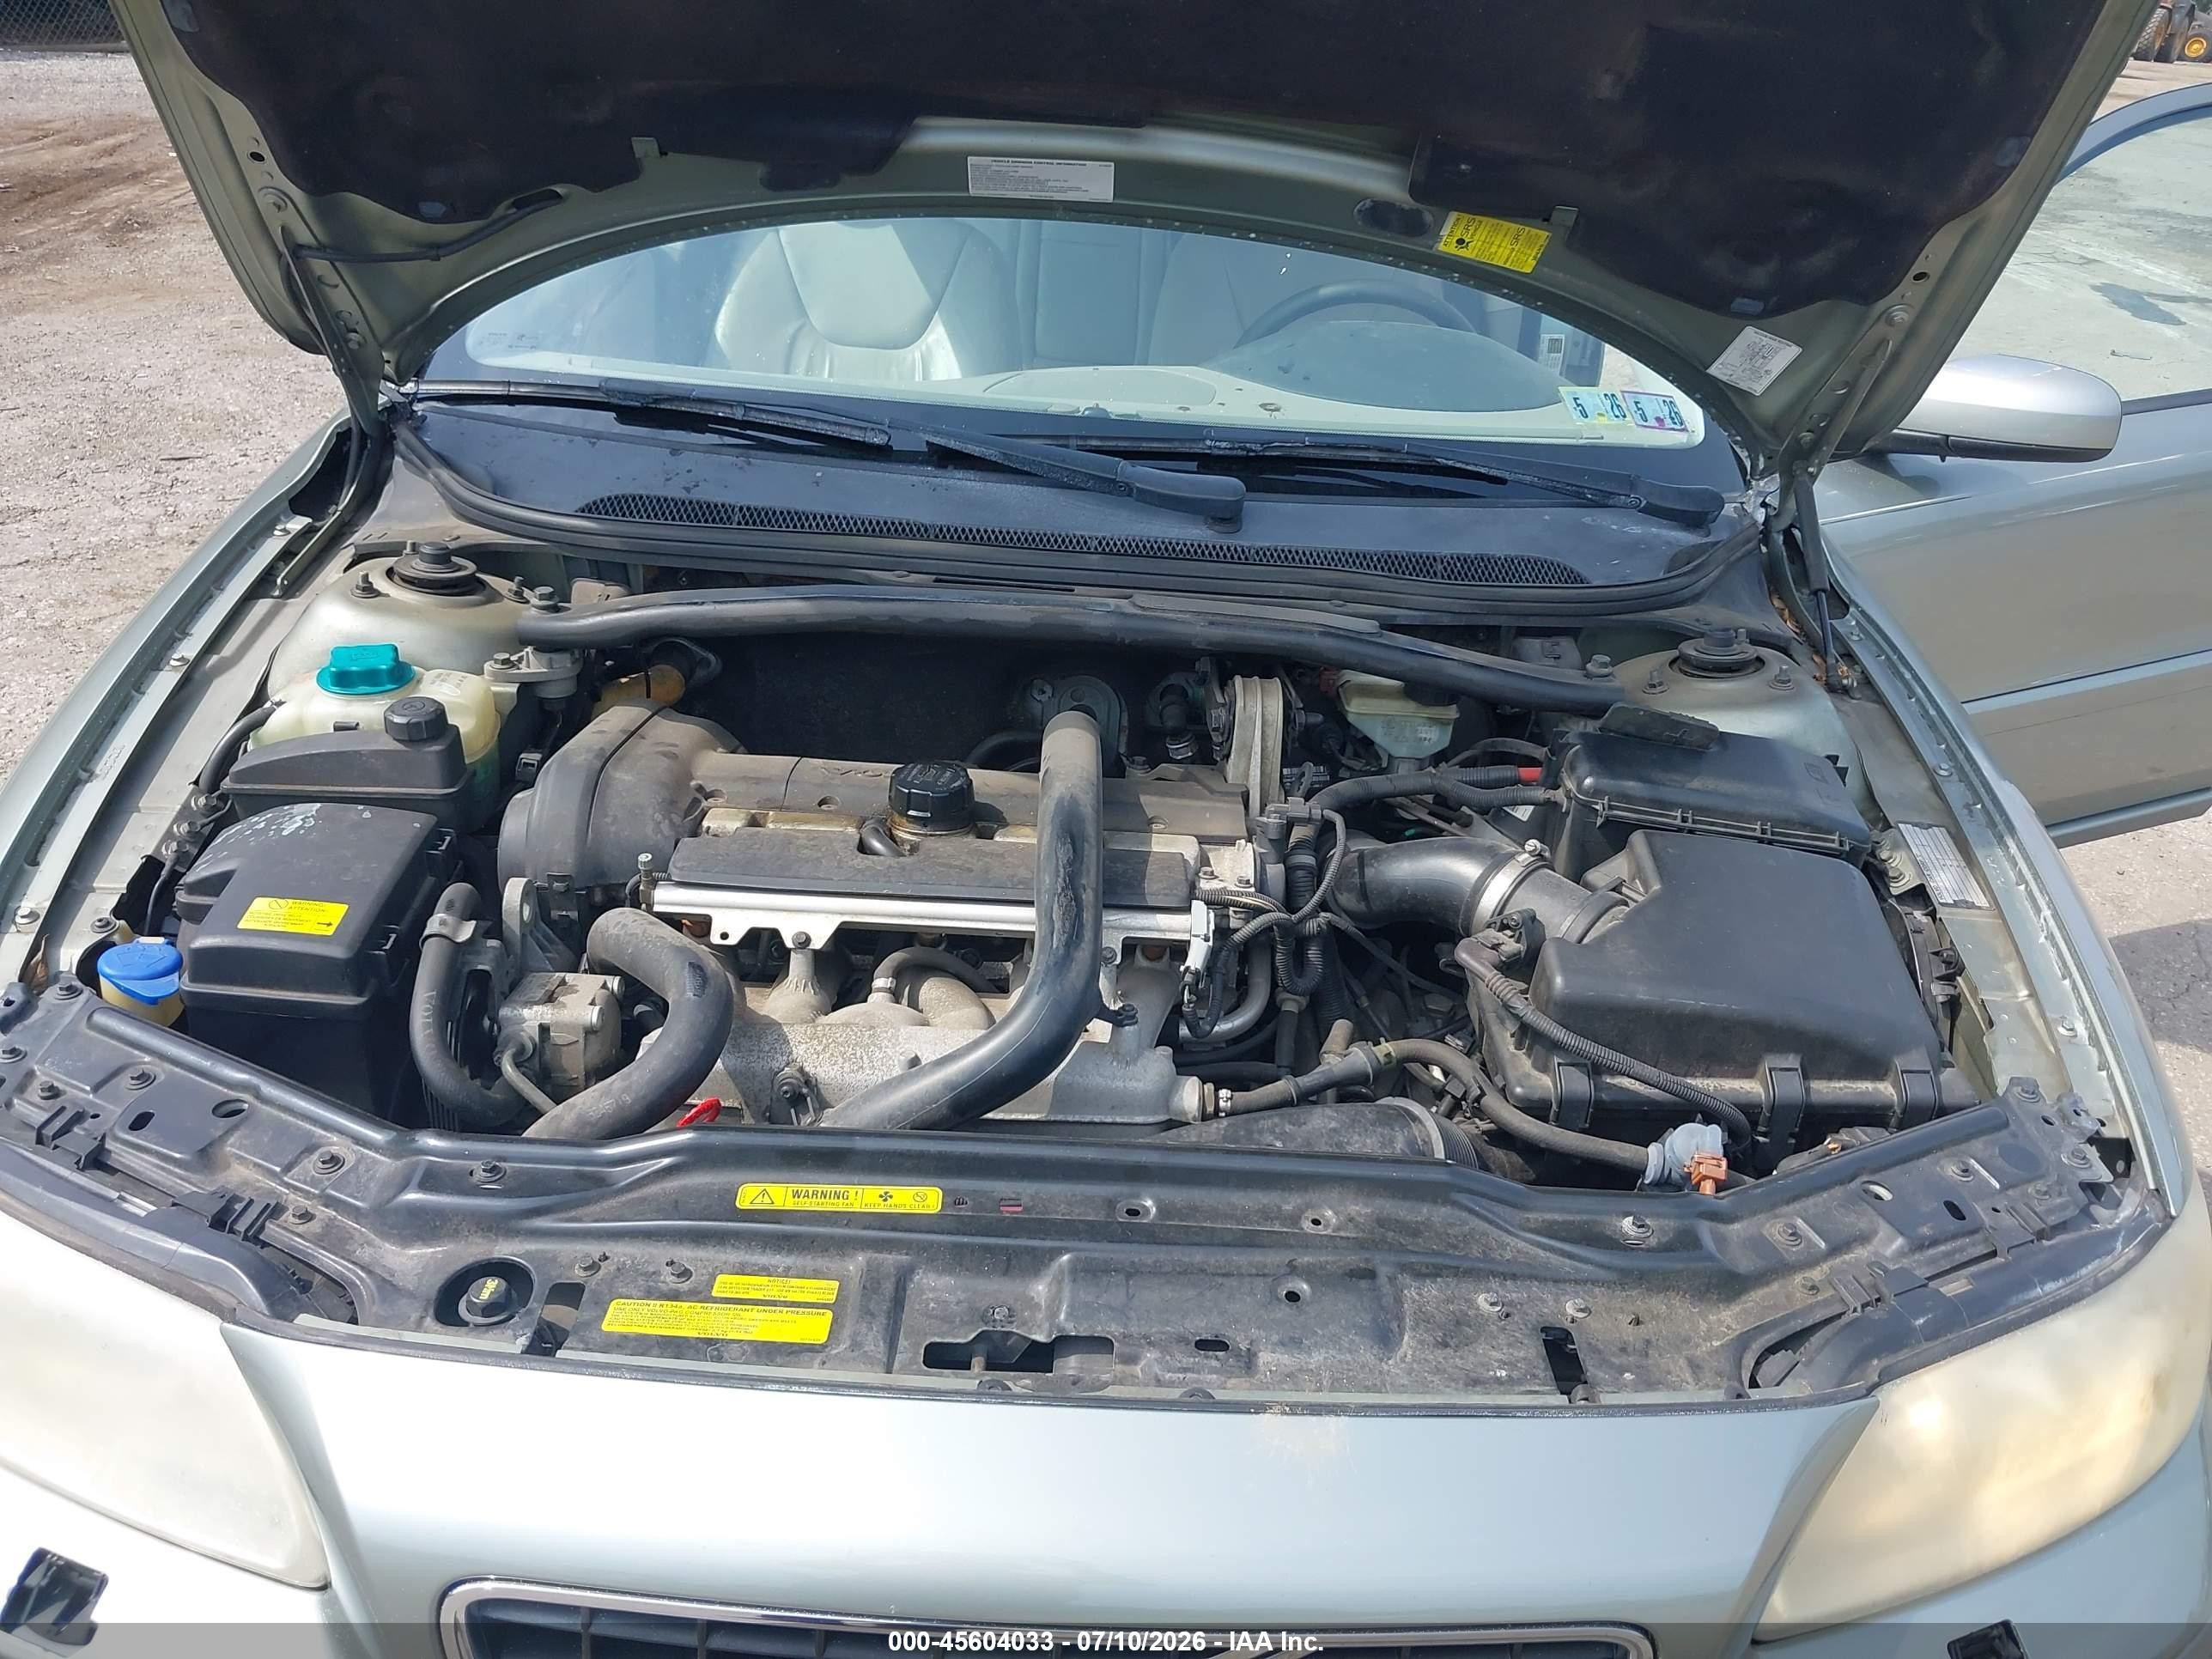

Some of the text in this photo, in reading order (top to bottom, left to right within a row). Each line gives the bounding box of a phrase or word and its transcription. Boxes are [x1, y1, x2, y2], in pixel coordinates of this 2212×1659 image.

[1461, 217, 1476, 237] SRS
[1510, 227, 1526, 247] SRS
[1573, 393, 1626, 419] 5 26
[1634, 399, 1684, 427] 5 26
[792, 1189, 849, 1200] WARNING
